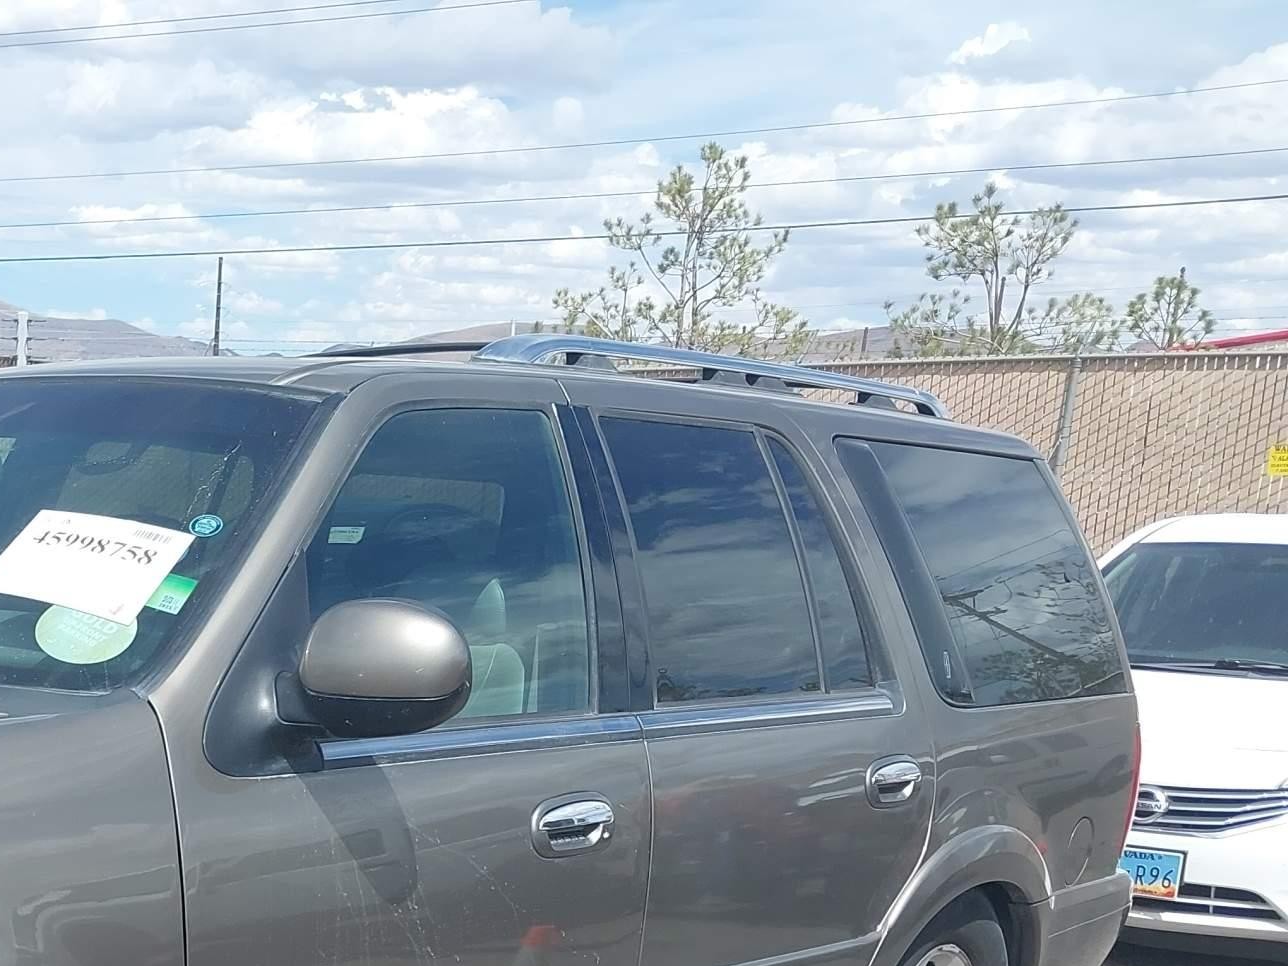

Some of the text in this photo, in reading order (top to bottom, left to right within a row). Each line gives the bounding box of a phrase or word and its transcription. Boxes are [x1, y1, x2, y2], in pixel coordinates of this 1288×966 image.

[33, 530, 158, 565] 45998758
[1124, 850, 1155, 860] VADA
[1129, 864, 1174, 889] R96
